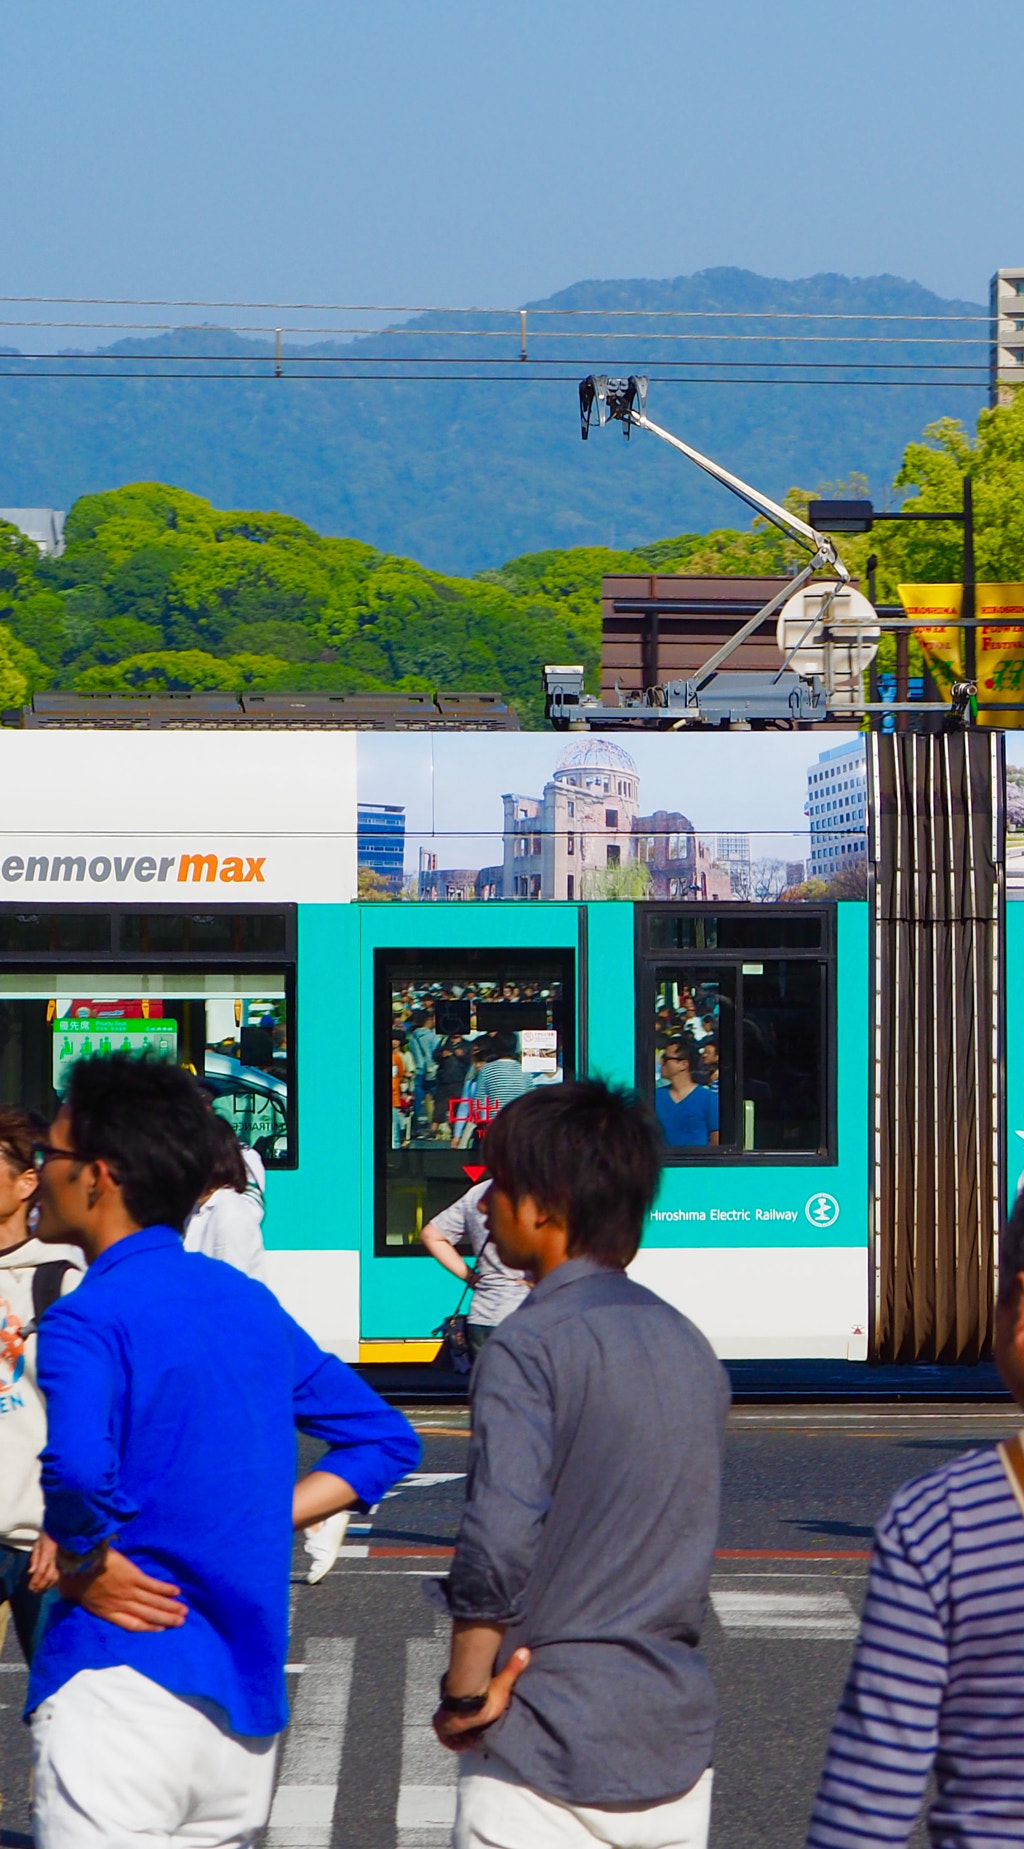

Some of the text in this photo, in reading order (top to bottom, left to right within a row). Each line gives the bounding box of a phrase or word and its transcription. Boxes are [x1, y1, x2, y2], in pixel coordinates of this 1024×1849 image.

[60, 1021, 90, 1031] 優先席
[650, 1209, 798, 1223] Hiroshima Electric Railway
